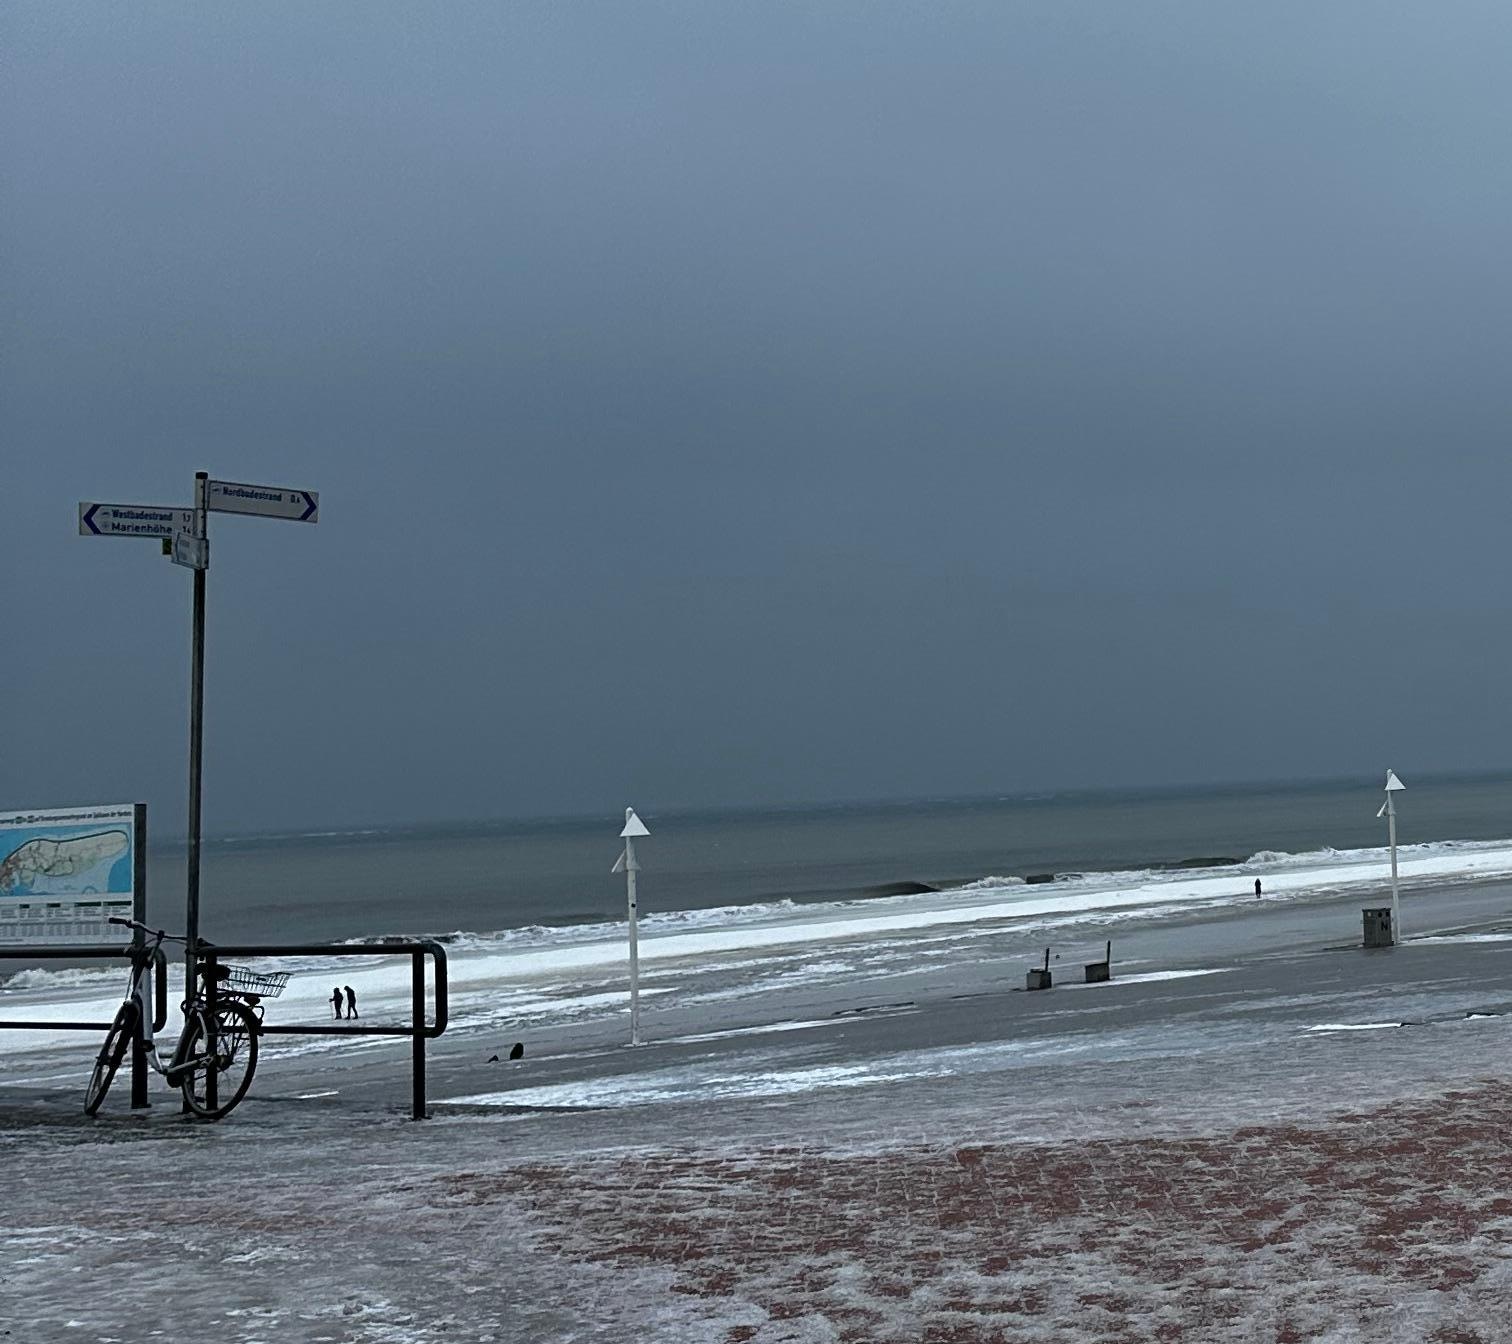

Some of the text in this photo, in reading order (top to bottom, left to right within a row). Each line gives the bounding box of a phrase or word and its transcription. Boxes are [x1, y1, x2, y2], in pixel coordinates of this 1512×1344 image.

[223, 486, 282, 502] Nordbadestrand
[111, 509, 173, 521] Westbadestrand
[112, 522, 172, 534] Marienhöhe
